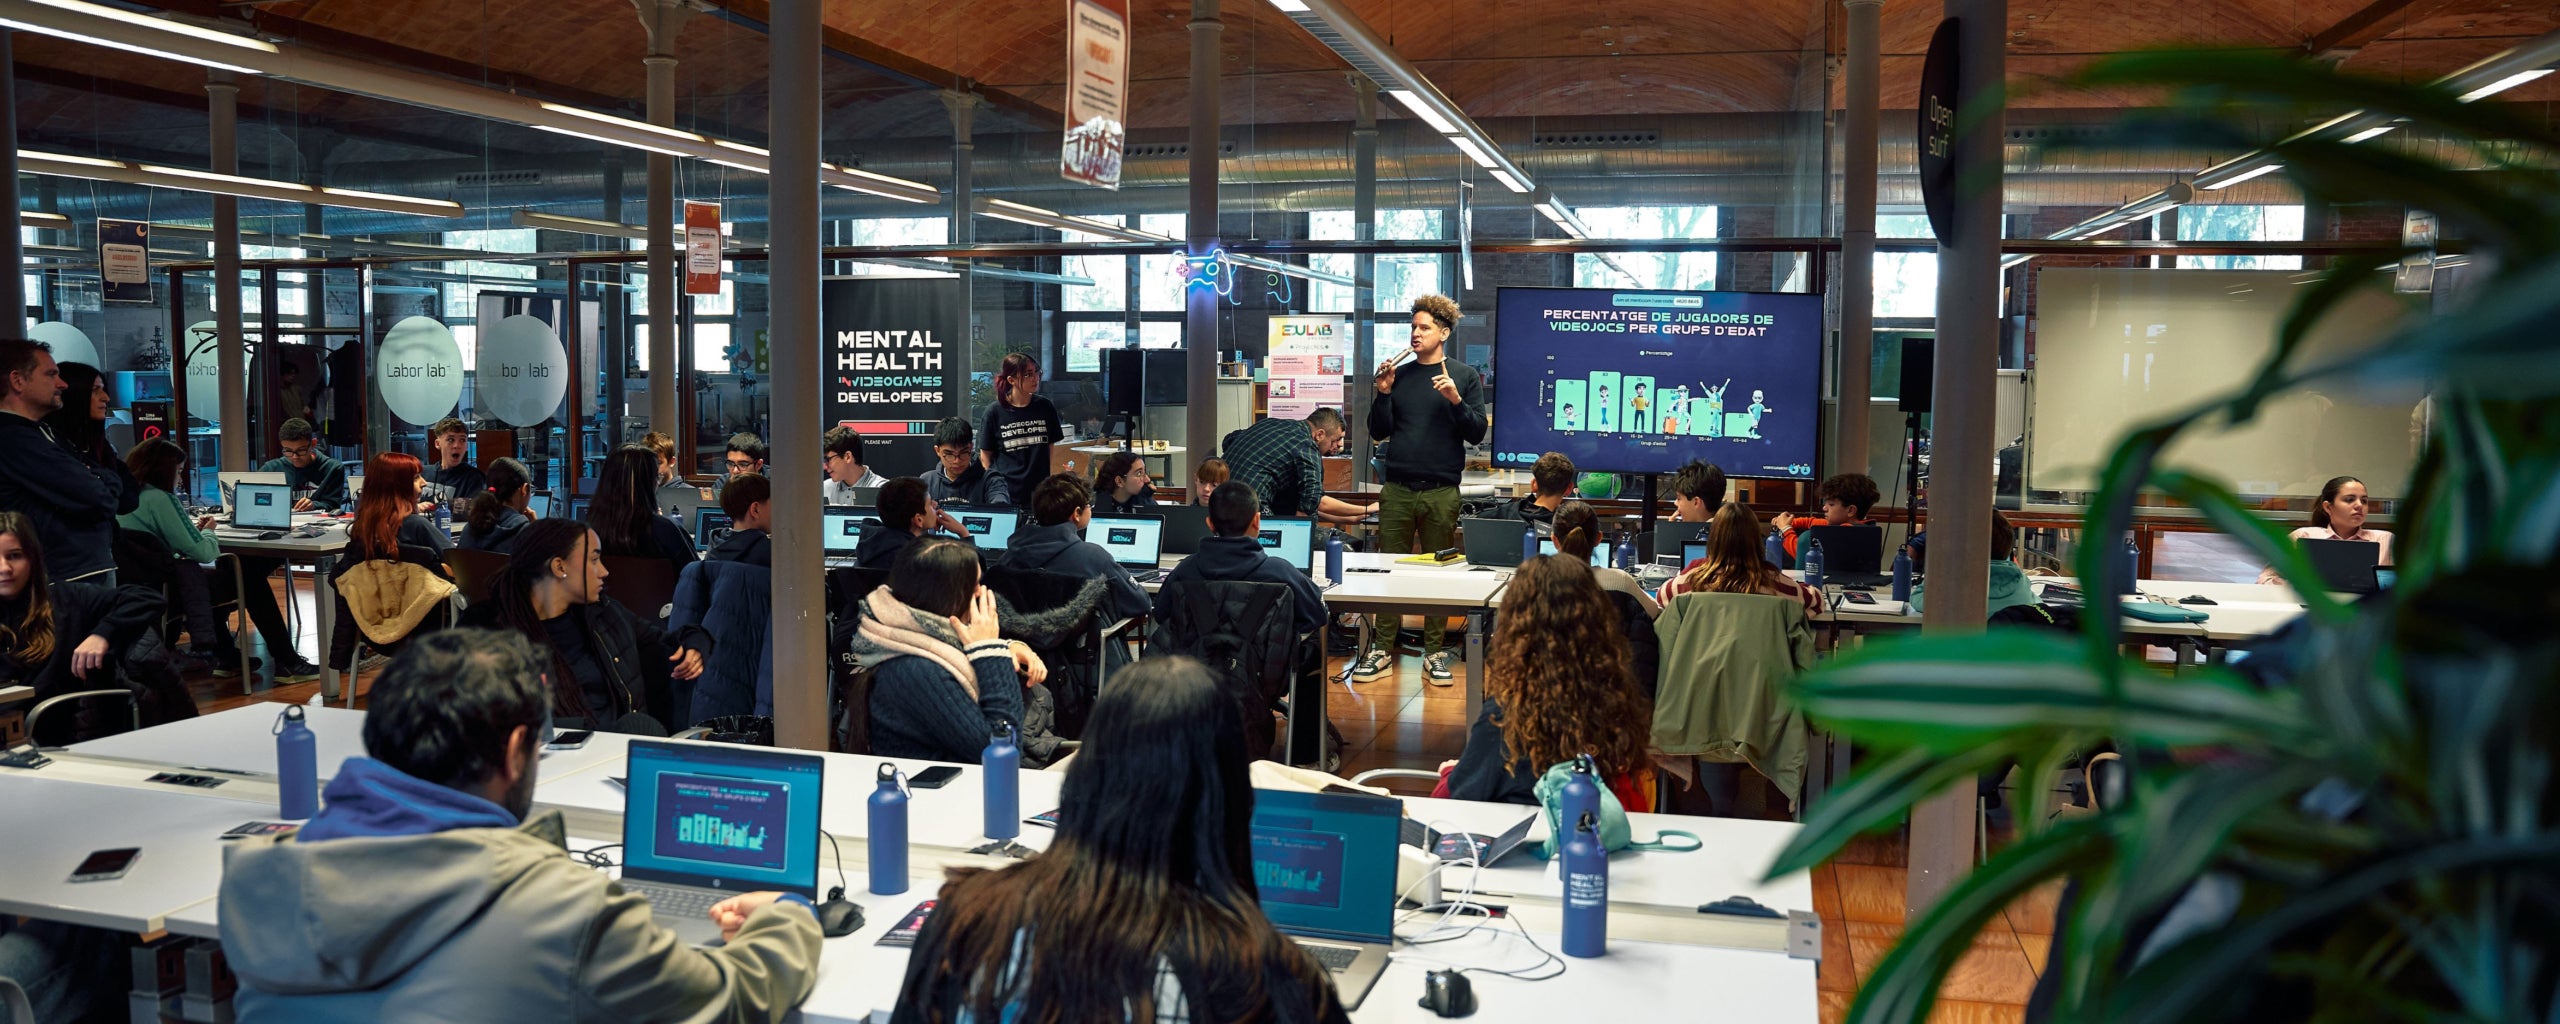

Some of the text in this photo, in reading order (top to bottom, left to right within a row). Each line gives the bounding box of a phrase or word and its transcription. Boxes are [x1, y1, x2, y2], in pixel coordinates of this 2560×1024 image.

[1931, 95, 1953, 131] Open
[1543, 309, 1774, 325] PERCENTATGE DE JUGADORS DE
[1549, 321, 1767, 337] VIDEOJOCS PER GRUPS D'EDAT
[837, 330, 942, 349] MENTAL
[837, 352, 943, 370] HEALTH
[386, 363, 446, 378] Labor lab
[528, 363, 549, 378] lab
[837, 391, 943, 403] DEVELOPERS
